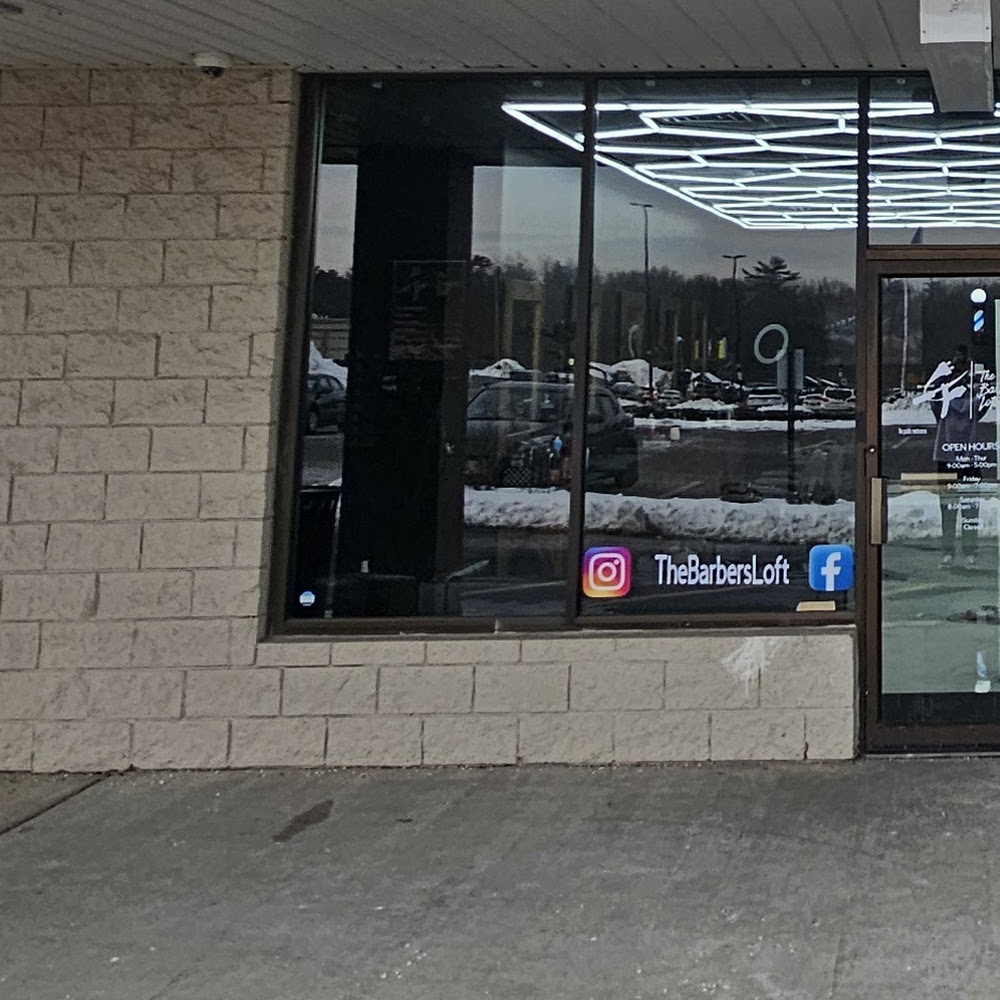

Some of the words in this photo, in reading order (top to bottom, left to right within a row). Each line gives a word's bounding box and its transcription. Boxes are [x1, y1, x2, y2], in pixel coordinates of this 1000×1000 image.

[974, 369, 996, 383] The
[941, 442, 967, 452] OPEN
[968, 441, 1000, 451] HOURS
[962, 475, 982, 484] Friday
[654, 554, 790, 586] TheBarbersLoft
